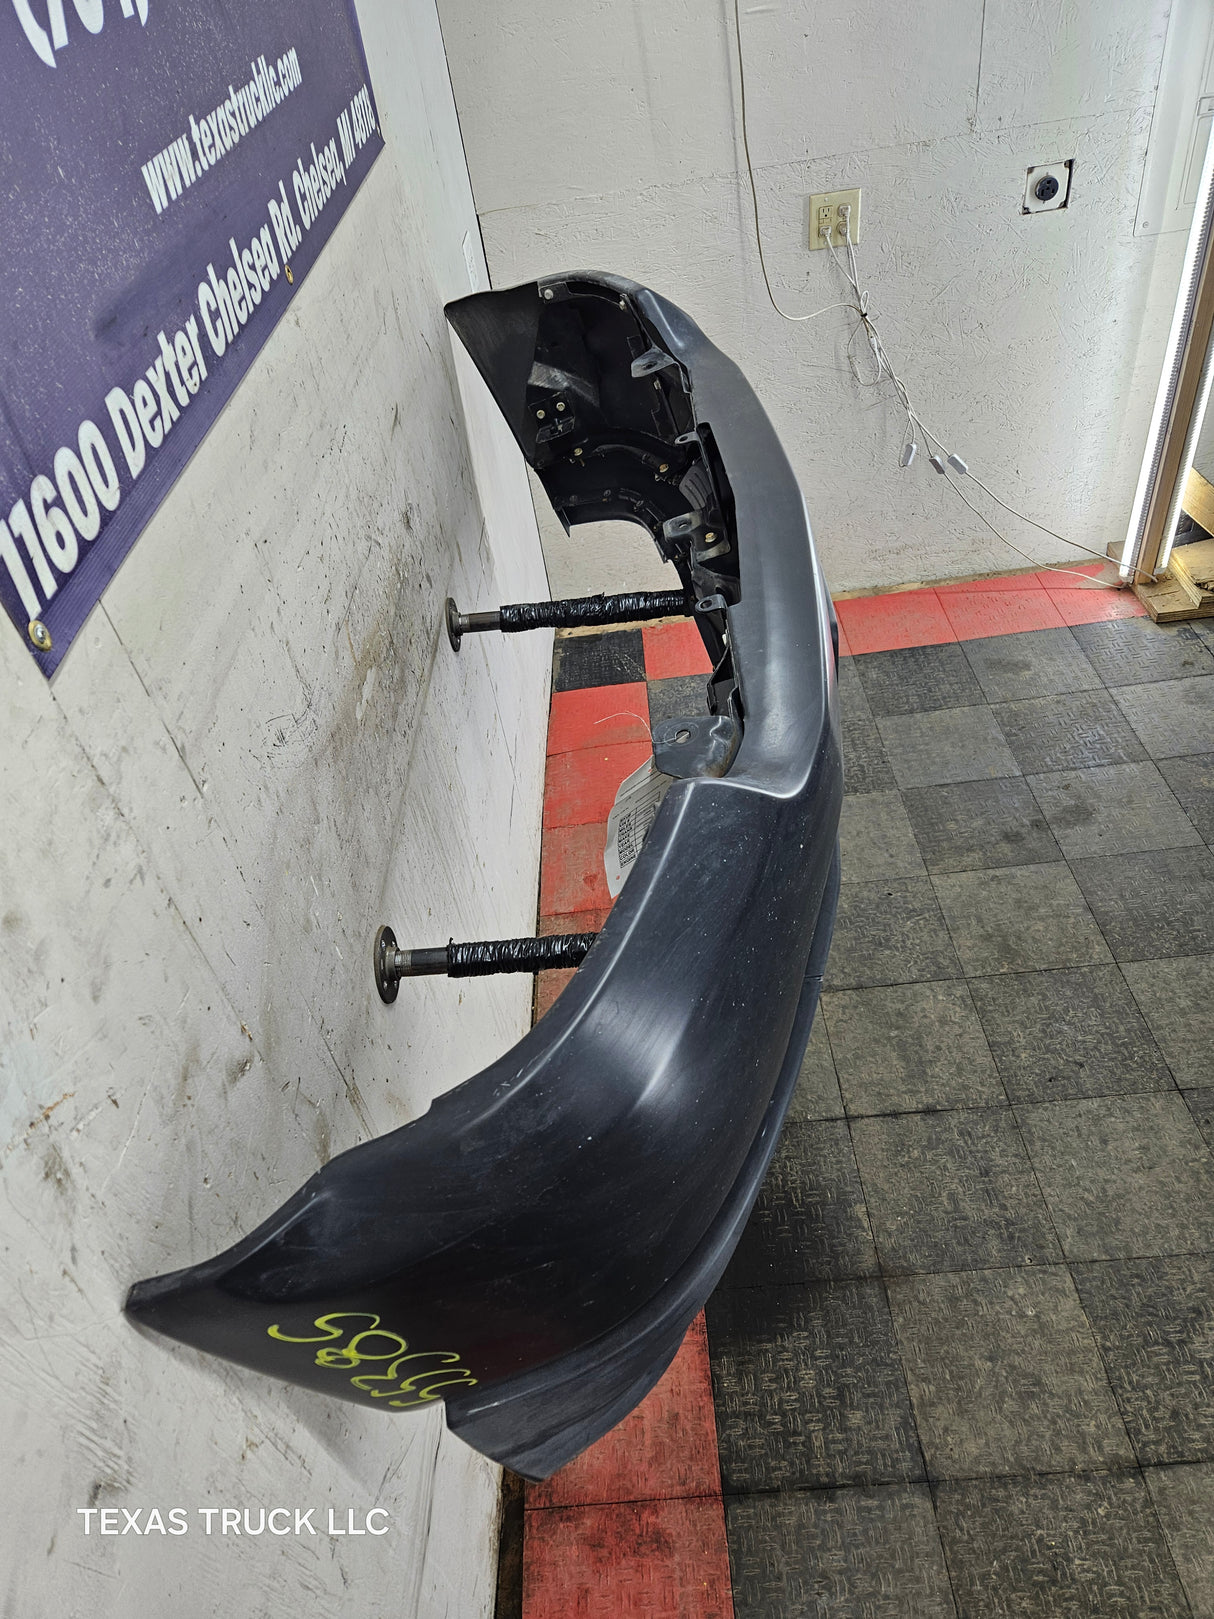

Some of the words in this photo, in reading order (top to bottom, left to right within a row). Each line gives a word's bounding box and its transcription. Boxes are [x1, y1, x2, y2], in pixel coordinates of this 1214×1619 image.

[141, 46, 302, 215] www.texastruckllc.com
[0, 420, 121, 621] 11600
[105, 314, 208, 479] Dexter
[198, 223, 280, 357] Chelsea
[267, 180, 302, 265] Rd.
[292, 137, 347, 231] Chelsea,
[336, 108, 356, 170] MI
